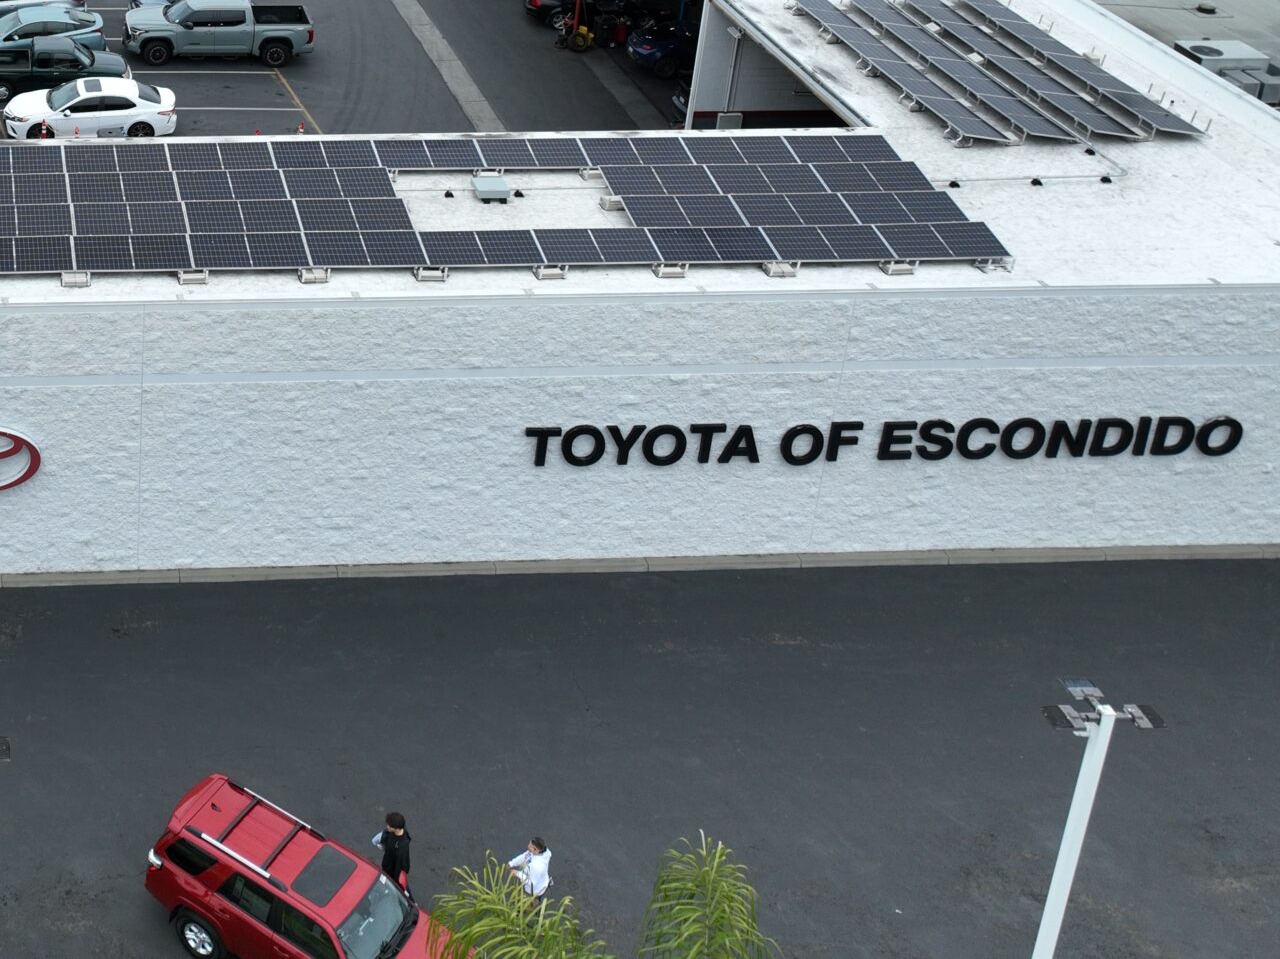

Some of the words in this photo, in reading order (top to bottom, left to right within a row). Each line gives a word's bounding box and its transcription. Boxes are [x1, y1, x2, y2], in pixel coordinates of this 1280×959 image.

[524, 422, 760, 468] TOYOTA
[779, 421, 865, 467] OF
[876, 415, 1244, 462] ESCONDIDO
